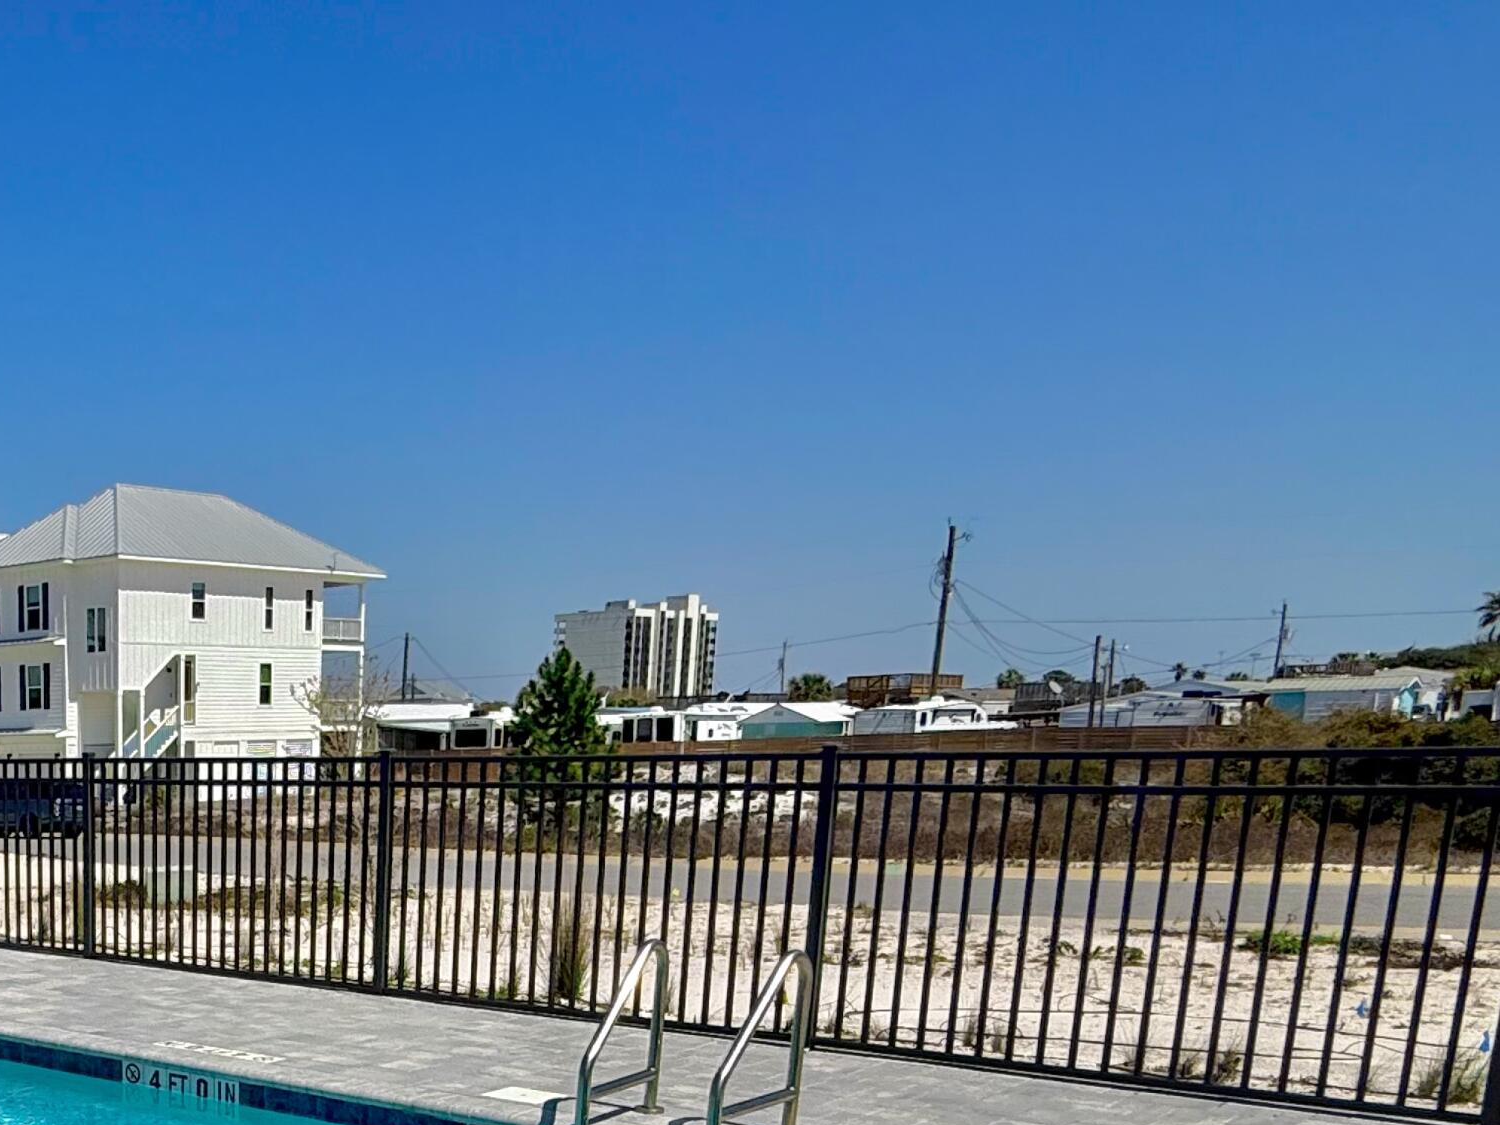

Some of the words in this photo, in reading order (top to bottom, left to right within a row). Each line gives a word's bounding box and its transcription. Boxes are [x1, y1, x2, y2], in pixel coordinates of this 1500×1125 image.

[149, 1070, 161, 1089] 4
[168, 1072, 188, 1093] FT
[196, 1078, 208, 1098] 0
[217, 1080, 235, 1103] IN
